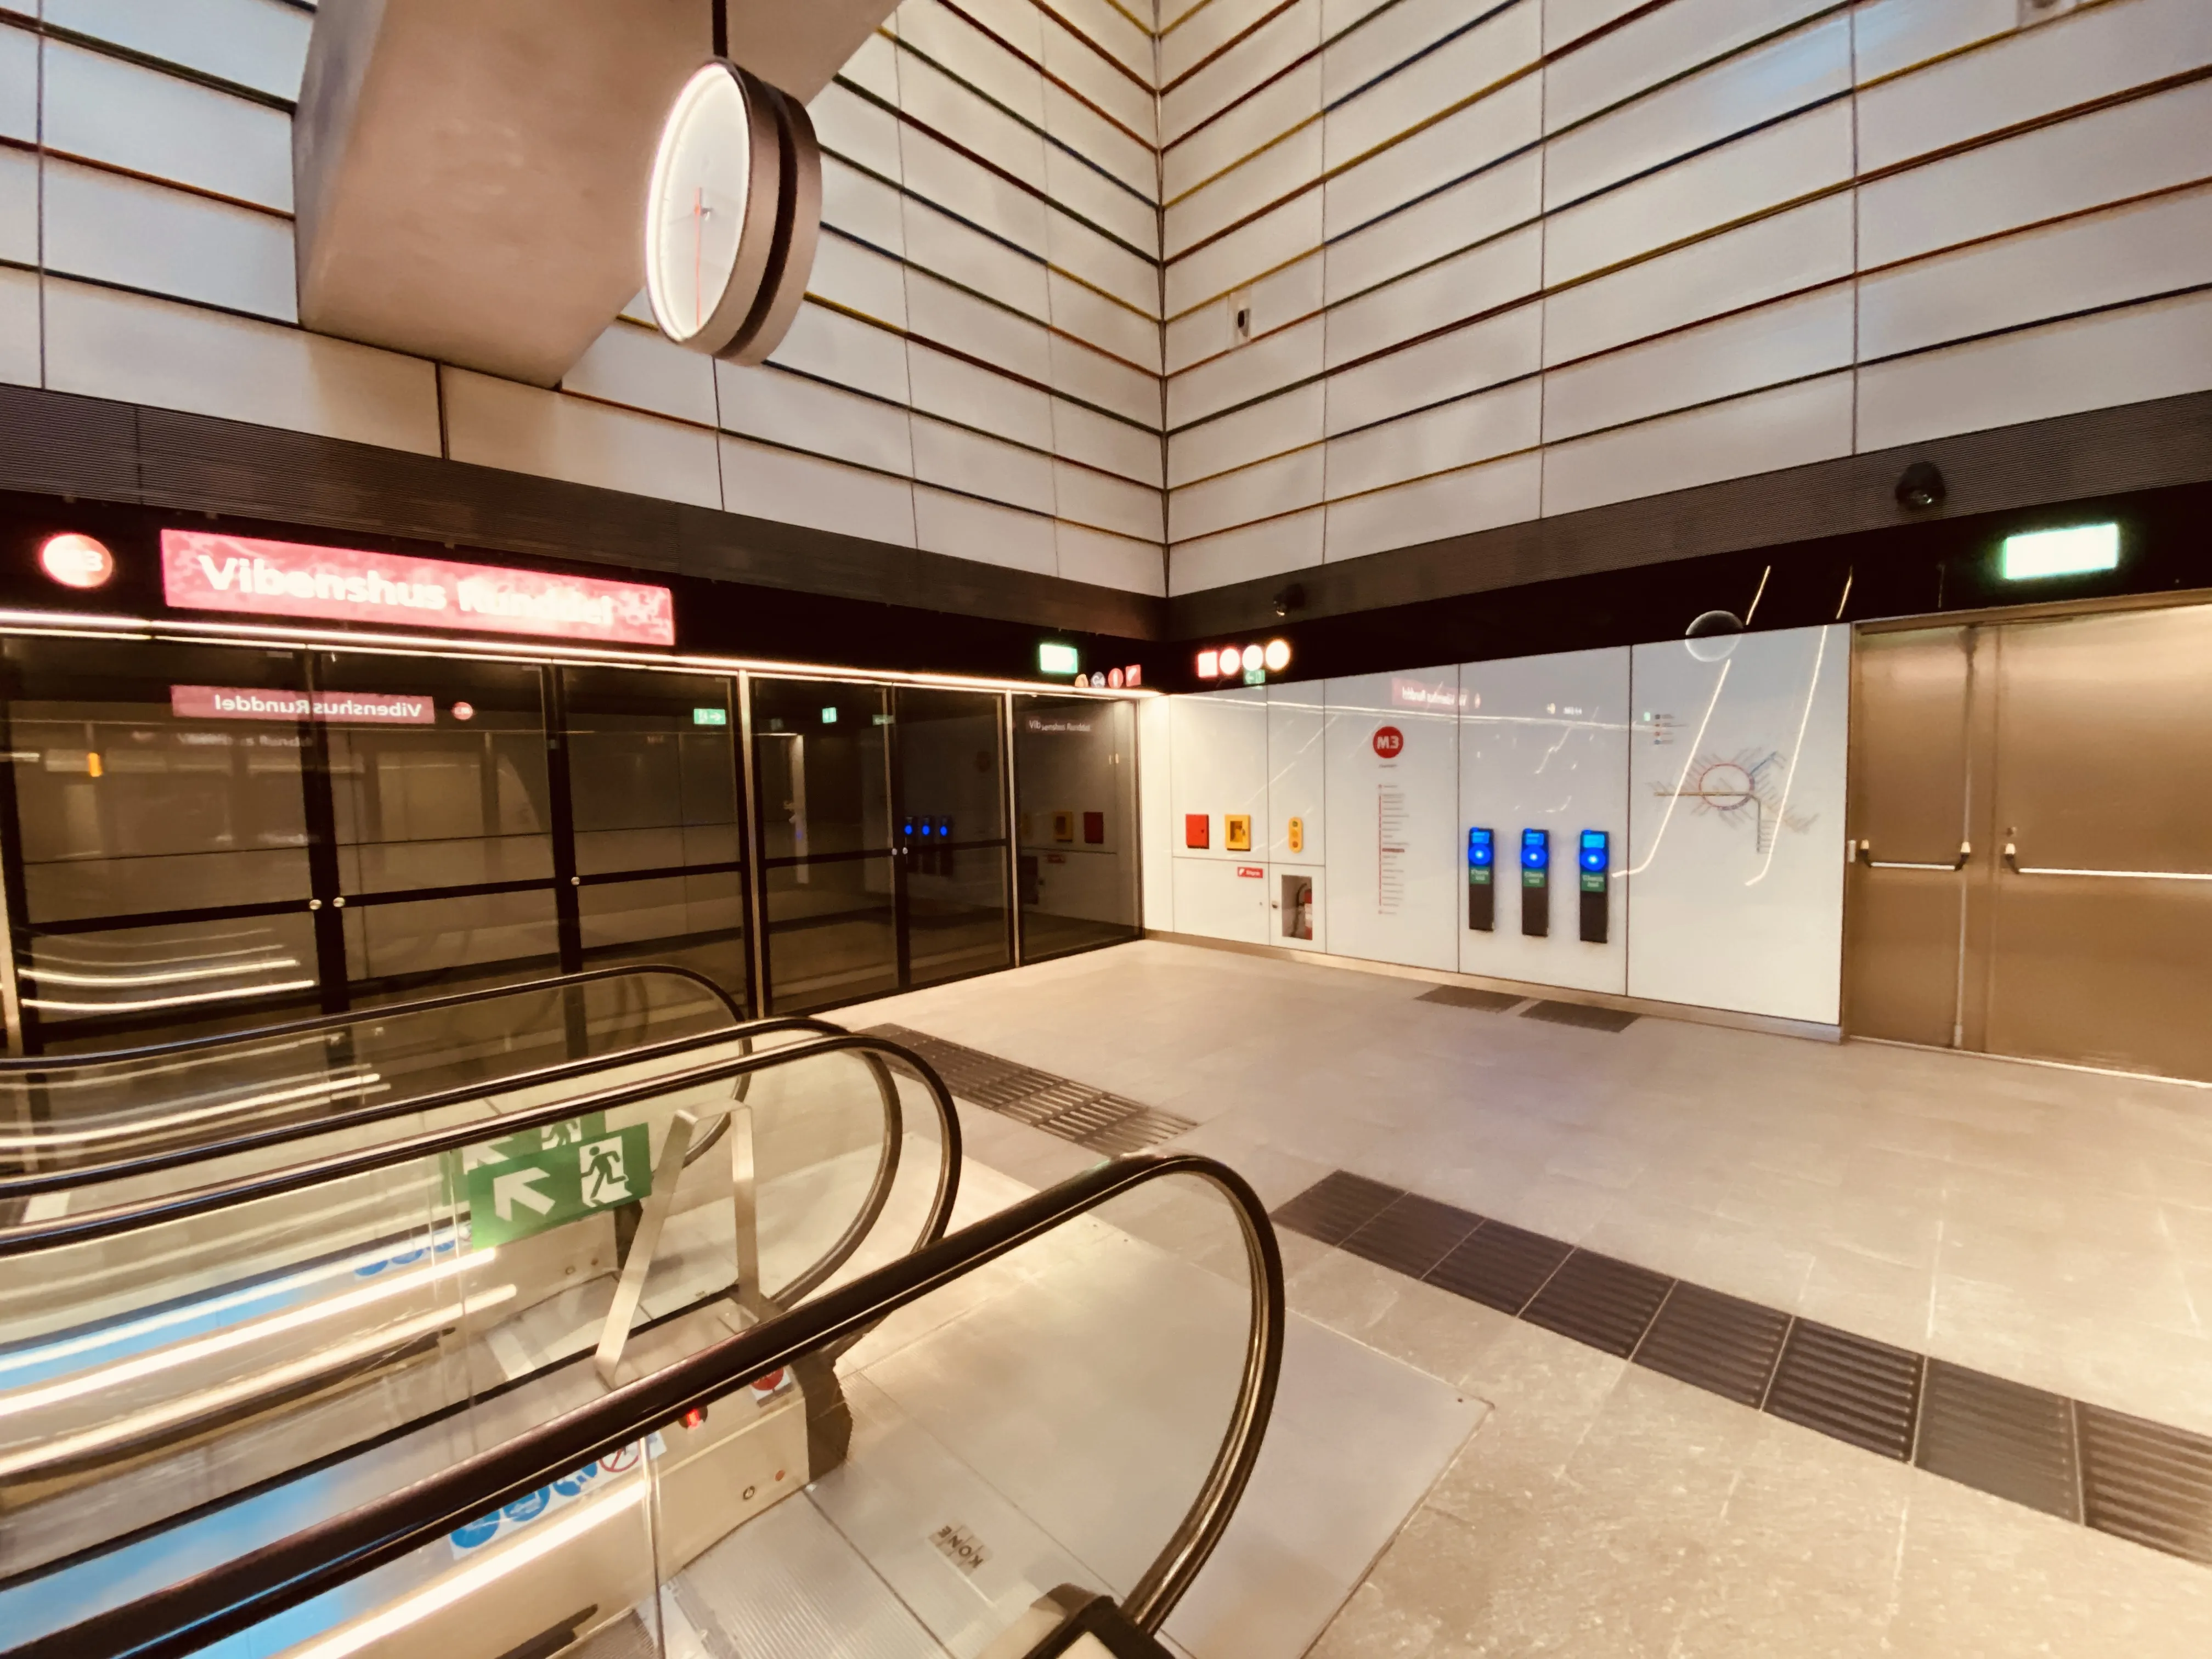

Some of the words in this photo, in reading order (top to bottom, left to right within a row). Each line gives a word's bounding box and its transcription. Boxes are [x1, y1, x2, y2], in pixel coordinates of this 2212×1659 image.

[199, 555, 446, 611] Vibenshus
[457, 580, 613, 625] Runddel
[1377, 735, 1399, 749] M3
[937, 1525, 984, 1569] KONE
